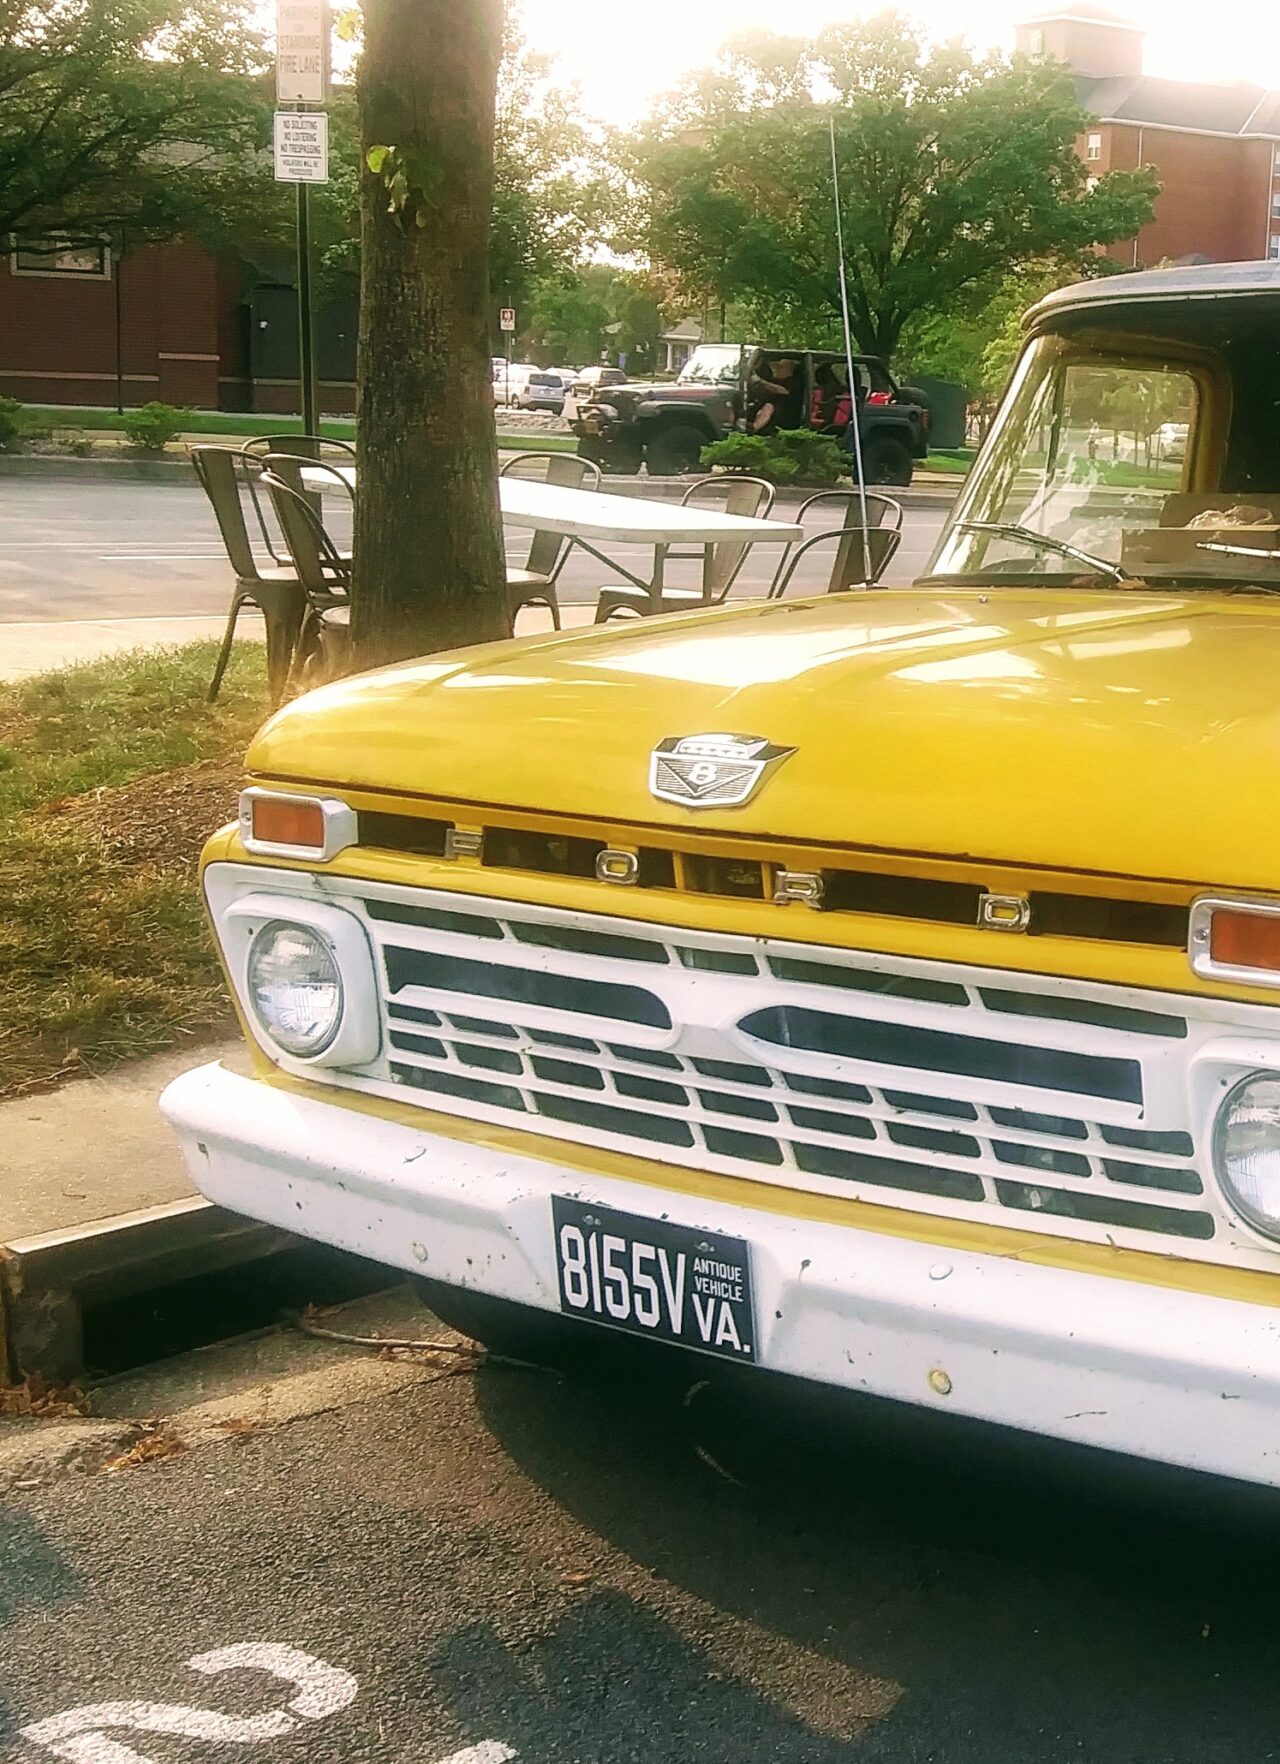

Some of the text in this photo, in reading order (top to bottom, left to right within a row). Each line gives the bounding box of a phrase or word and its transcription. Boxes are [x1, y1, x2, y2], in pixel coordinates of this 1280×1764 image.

[280, 35, 320, 49] STANDING
[280, 55, 320, 73] FIRE LANE
[283, 120, 318, 130] NO SOLICITING
[284, 132, 317, 142] NO LOITERING
[280, 143, 321, 154] NO TRESPASSING
[560, 1224, 686, 1334] 8155V
[693, 1257, 743, 1283] ANTIQUE
[694, 1275, 744, 1302] VEHICLE
[692, 1293, 751, 1353] VA.
